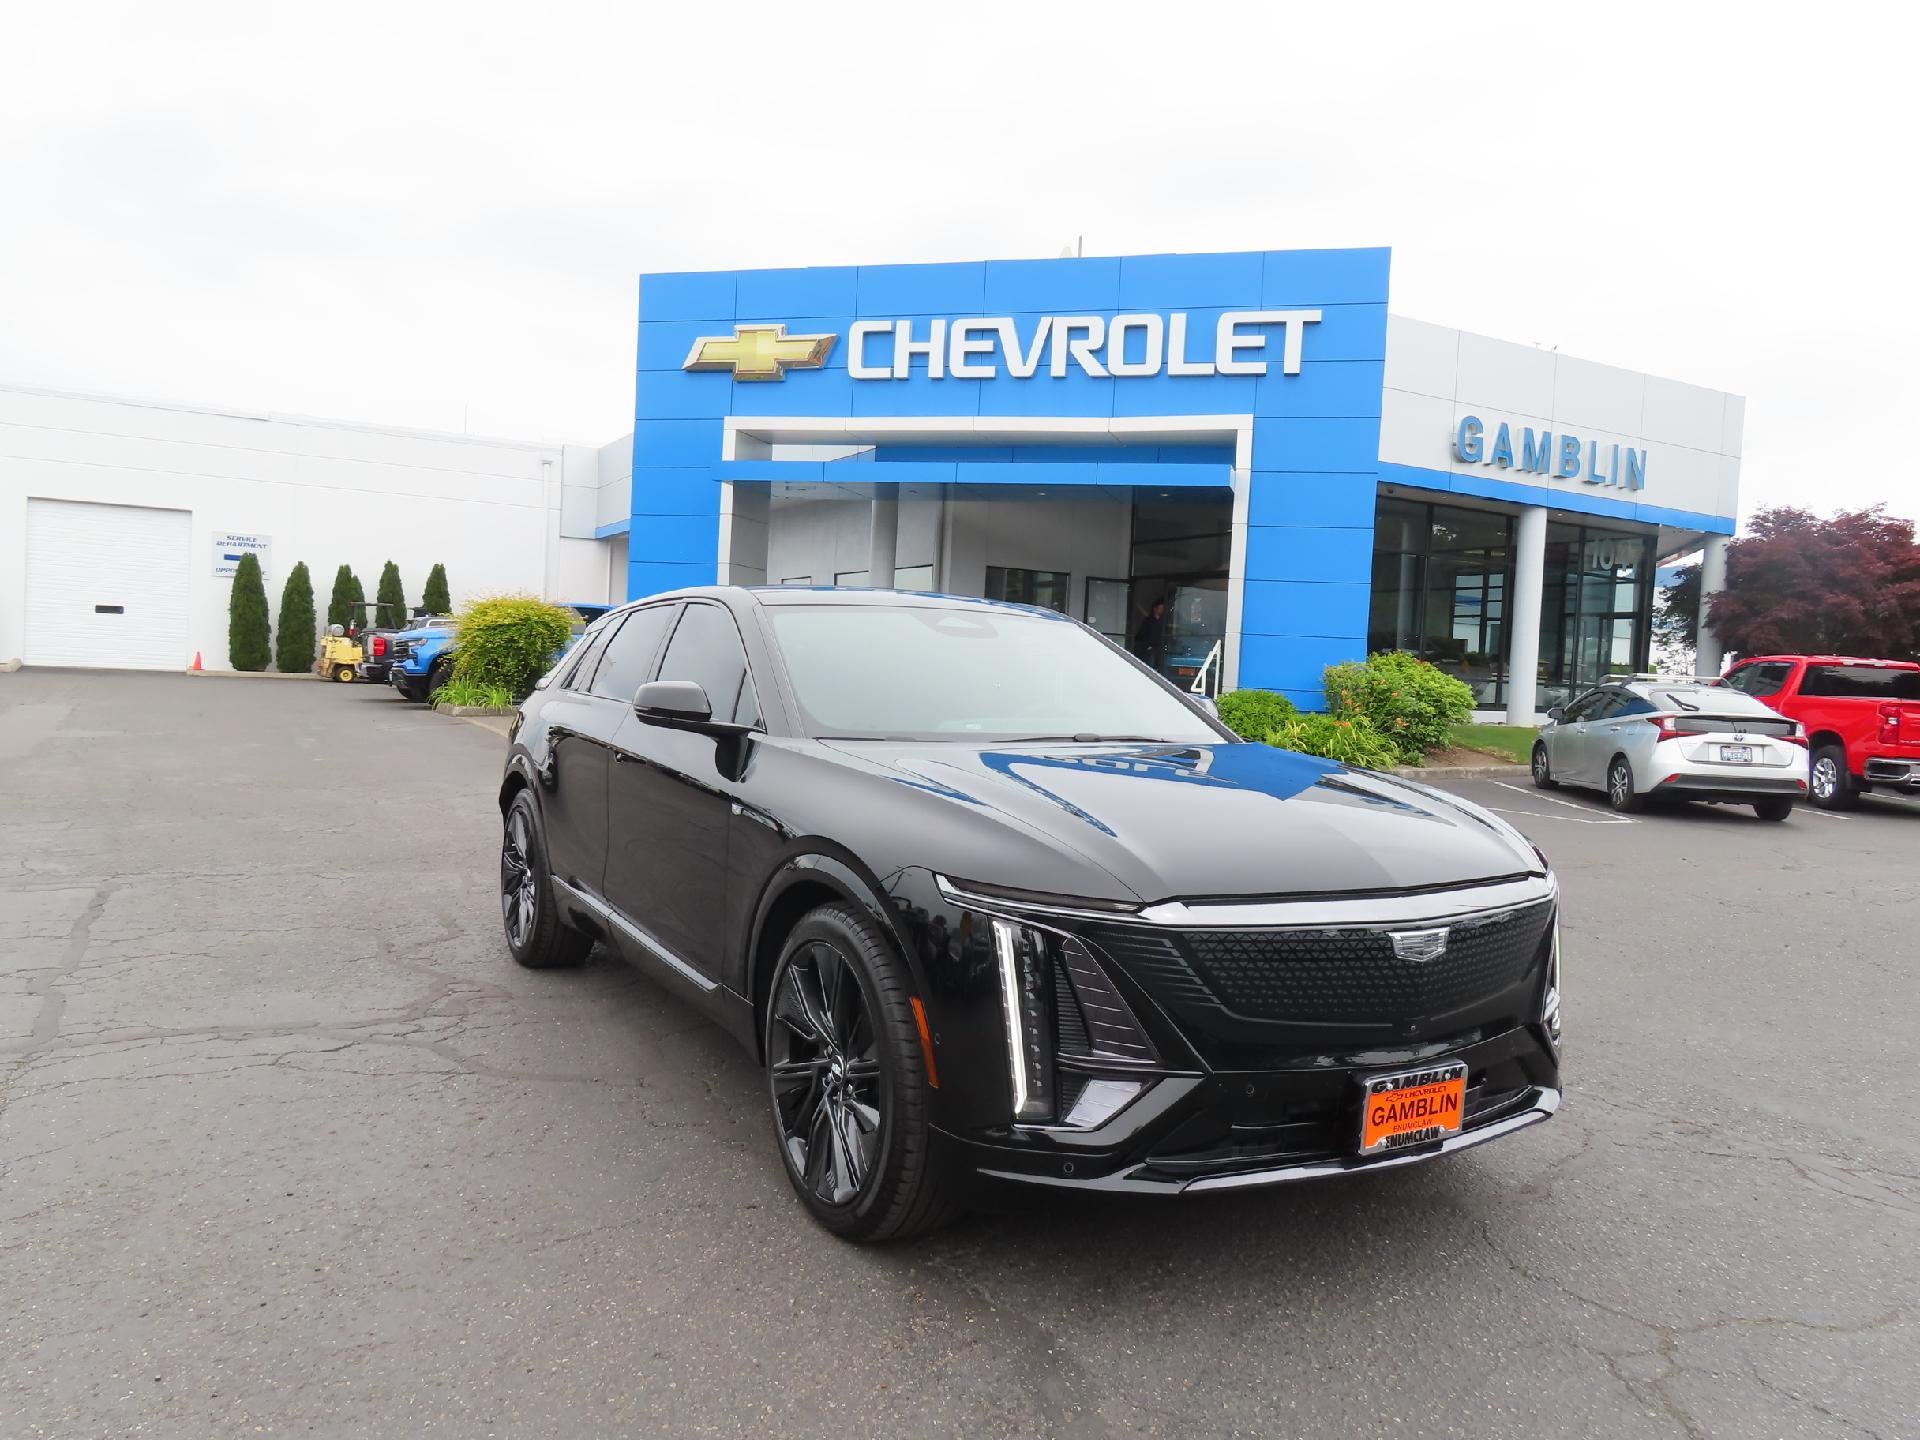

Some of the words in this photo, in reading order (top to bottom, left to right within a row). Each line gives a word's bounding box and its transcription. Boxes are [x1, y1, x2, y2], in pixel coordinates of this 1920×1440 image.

[848, 310, 1322, 380] CHEVROLET
[1455, 415, 1647, 491] GAMBLIN
[216, 541, 268, 549] DEPARTMENT
[226, 535, 257, 543] SERVICE
[1372, 1093, 1457, 1127] GAMBLIN
[1385, 1126, 1440, 1149] ENUMCLAW
[1393, 1119, 1432, 1133] ENUMCLAW
